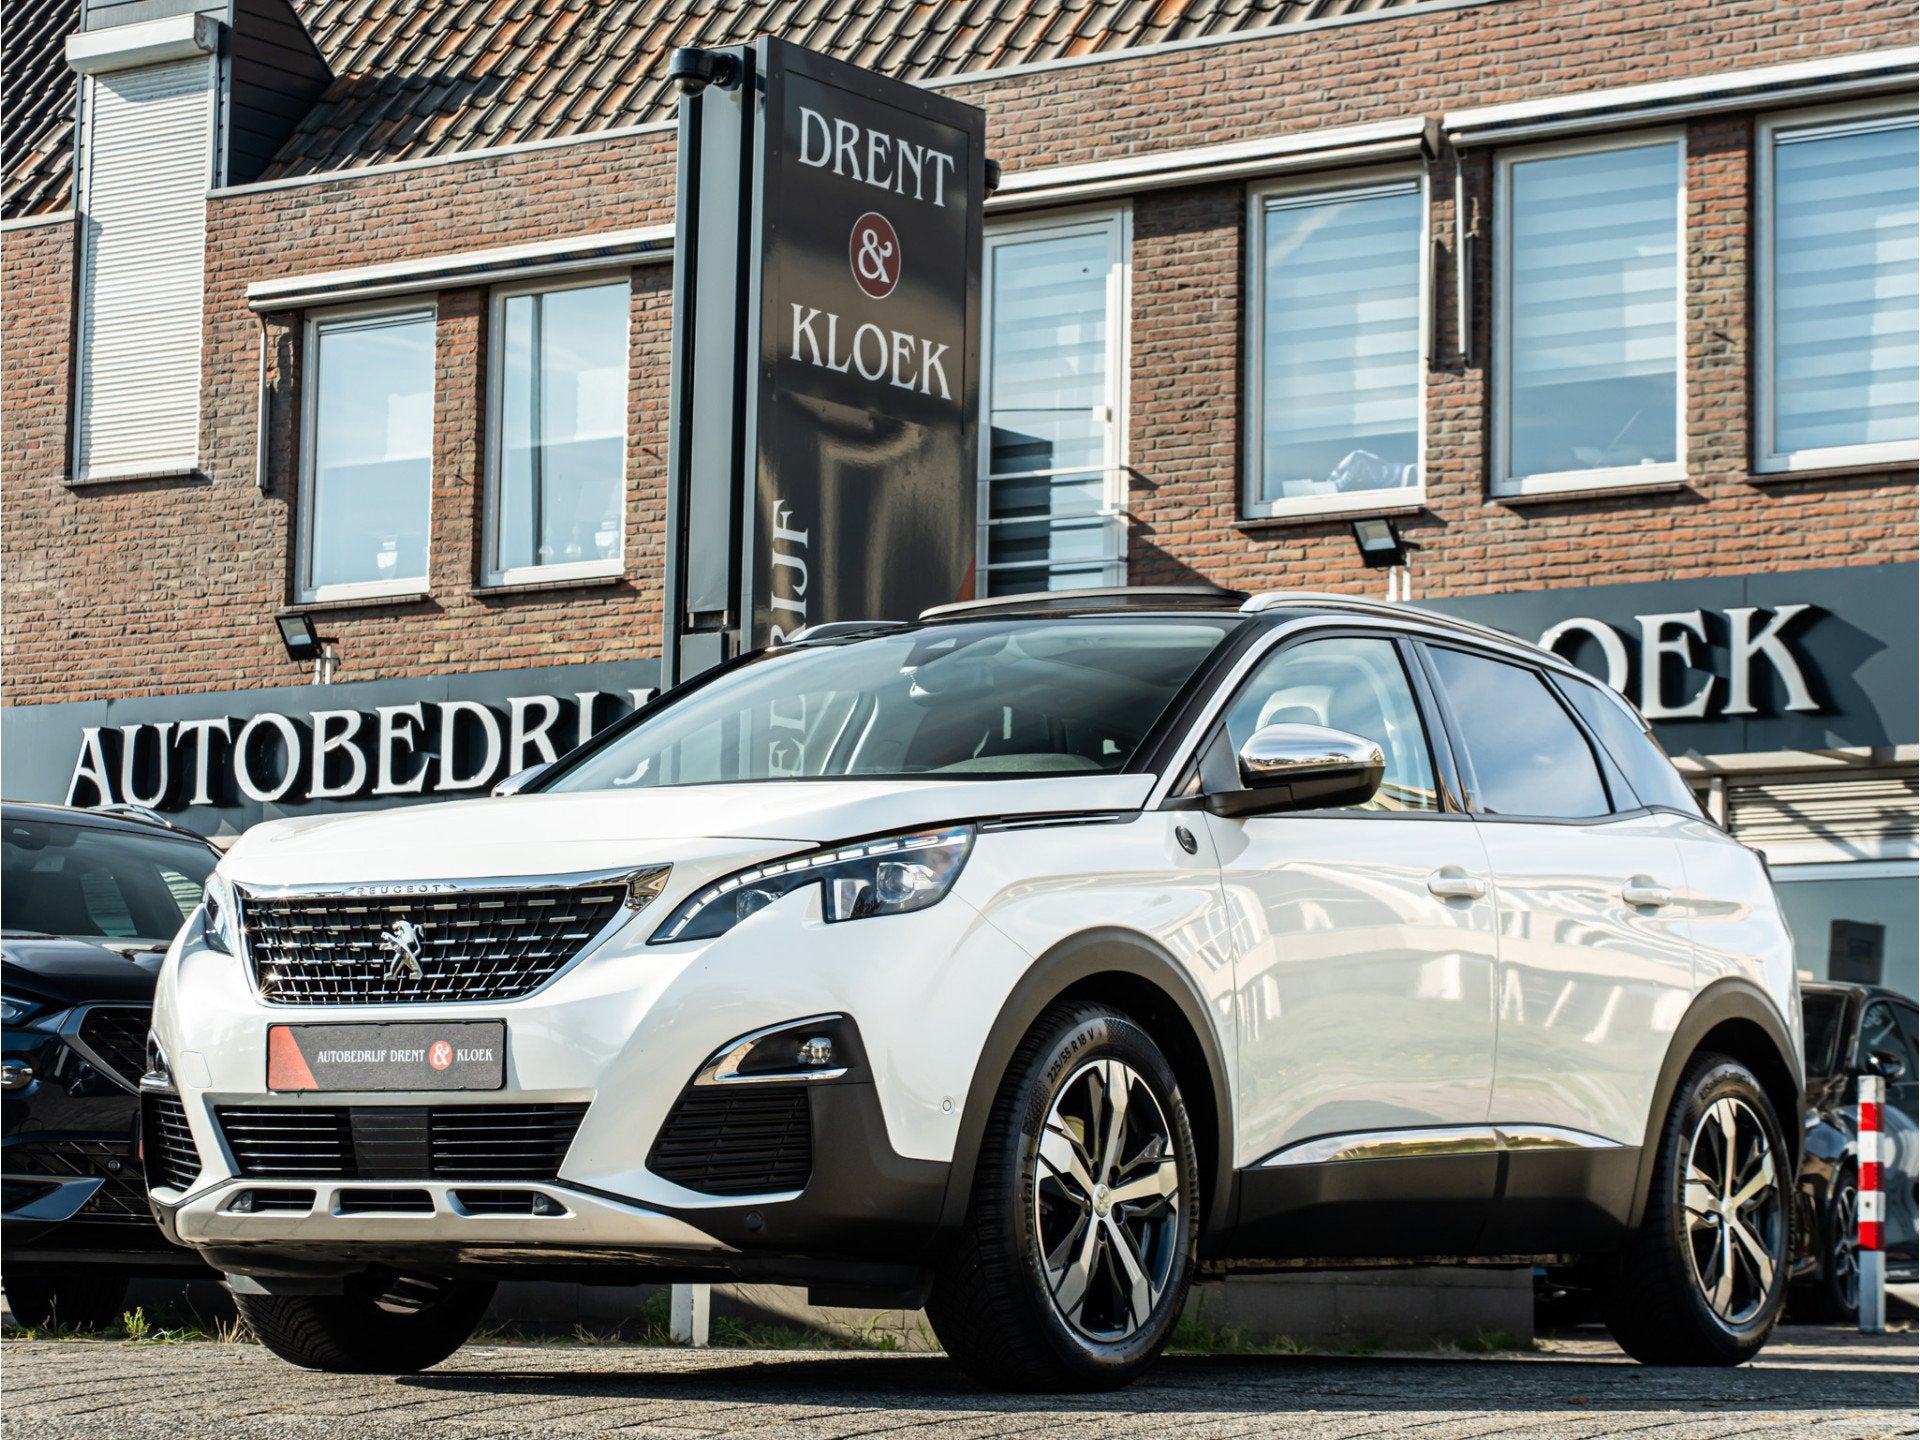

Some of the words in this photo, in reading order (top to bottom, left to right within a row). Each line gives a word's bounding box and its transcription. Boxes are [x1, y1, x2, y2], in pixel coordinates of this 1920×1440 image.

[798, 106, 955, 208] DRENT
[857, 229, 893, 283] &
[790, 302, 952, 400] KLOEK
[356, 884, 441, 896] PEUGEOT
[316, 1049, 387, 1063] AUTOBEDRIJF
[390, 1049, 426, 1062] DRENT
[433, 1043, 450, 1066] &
[456, 1048, 493, 1062] KLOEK
[1047, 1046, 1072, 1083] 225/55
[1070, 1040, 1079, 1053] R
[1077, 1033, 1087, 1047] 18
[1087, 1027, 1094, 1041] V
